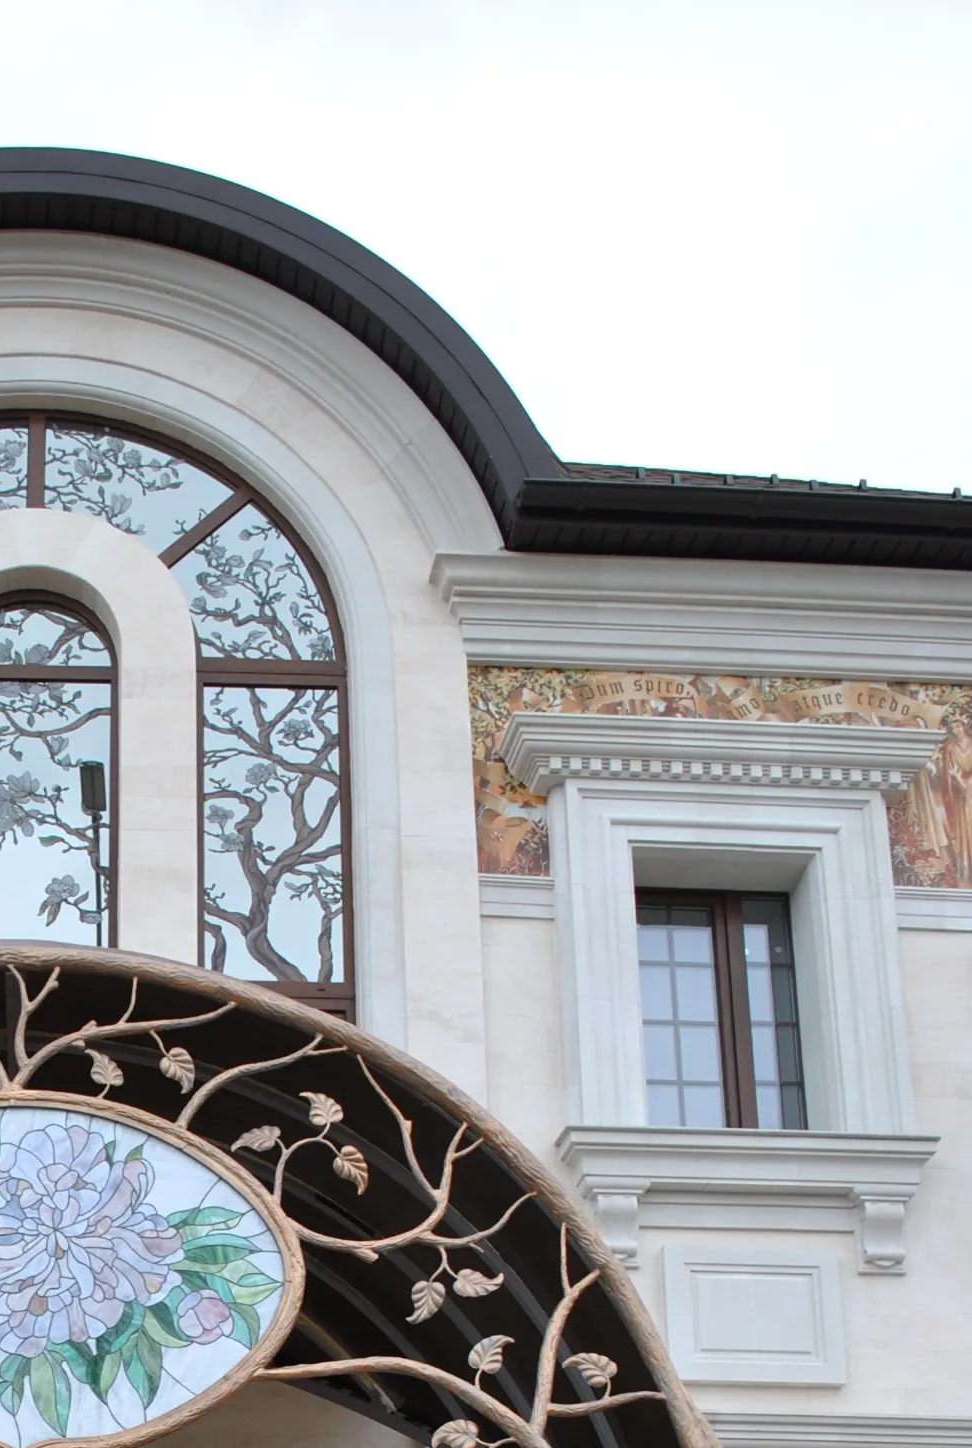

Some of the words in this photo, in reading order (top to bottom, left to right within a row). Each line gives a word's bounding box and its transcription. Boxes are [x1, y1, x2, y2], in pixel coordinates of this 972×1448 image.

[578, 680, 625, 701] Dum
[633, 677, 690, 696] spiro,
[726, 697, 761, 720] amo
[793, 691, 843, 713] atque
[857, 691, 910, 716] credo
